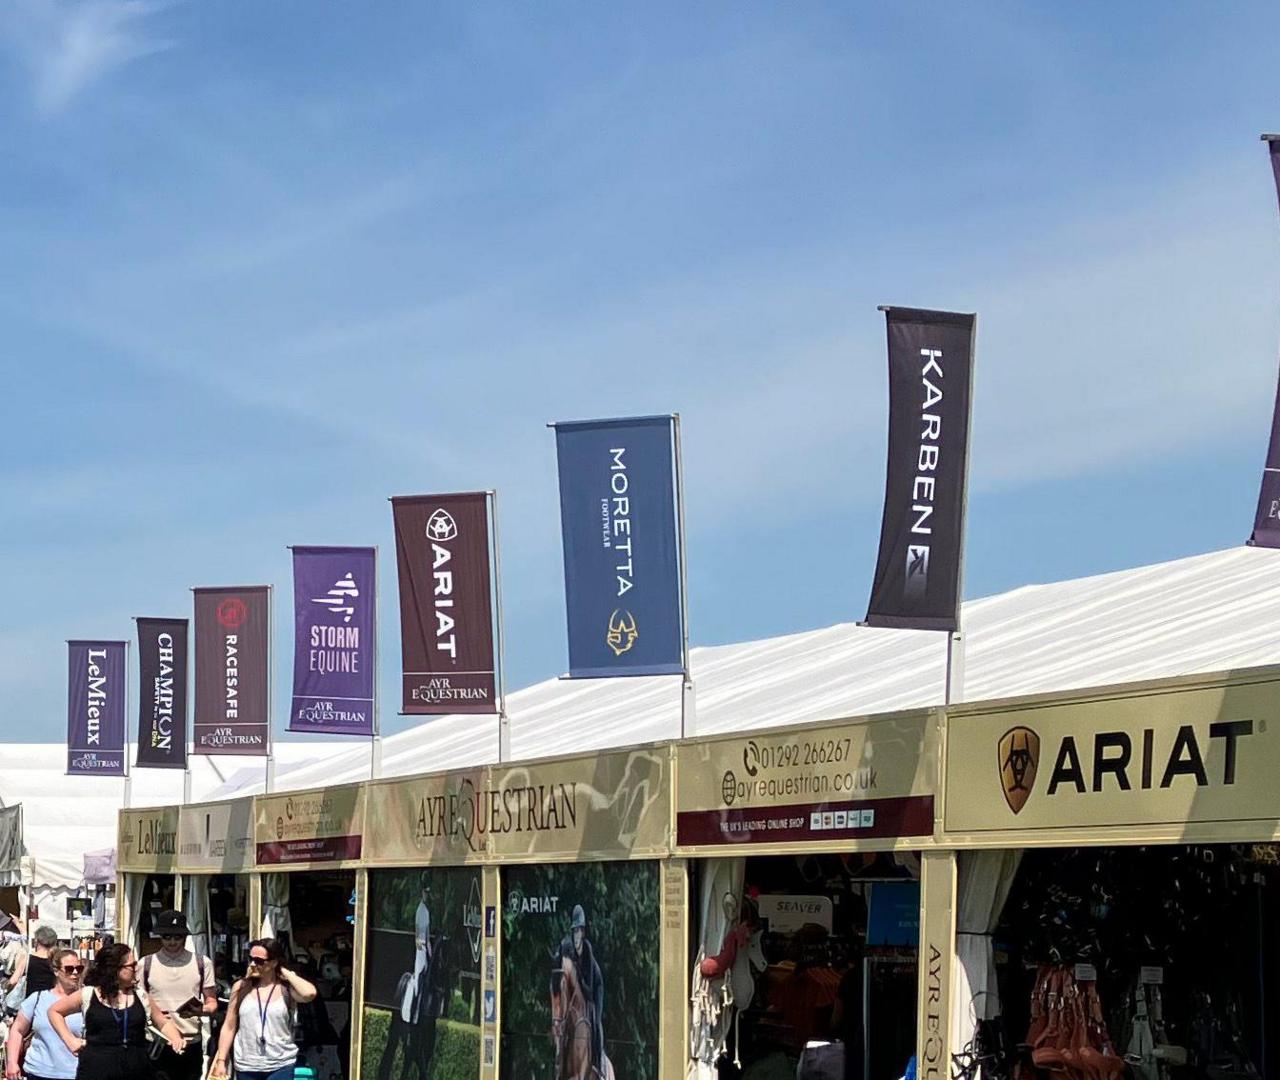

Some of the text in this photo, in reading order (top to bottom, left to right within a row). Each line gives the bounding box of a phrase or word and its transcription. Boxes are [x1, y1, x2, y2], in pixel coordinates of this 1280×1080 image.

[911, 348, 943, 534] KARBEN
[609, 448, 634, 597] MORETTA
[431, 543, 457, 658] ARIAT
[311, 625, 359, 648] STORM
[309, 649, 359, 675] EQUINE
[226, 634, 238, 719] RACESAFE
[428, 678, 450, 688] AYR
[87, 648, 107, 745] LeMieux
[157, 632, 173, 750] CHAMPION
[412, 686, 488, 702] EQUESTRIAN
[298, 708, 366, 723] EQUESTRIAN
[313, 701, 334, 711] AYR
[201, 733, 263, 747] EQUESTRIAN
[214, 727, 233, 737] AYR
[761, 738, 851, 769] 01292 266267
[1046, 720, 1254, 795] ARIAT
[736, 766, 878, 803] ayrequestrian.co.uk
[767, 818, 788, 830] ONLINE
[789, 817, 805, 829] SHOP
[521, 896, 559, 914] ARIAT
[776, 900, 823, 914] SEAVER
[928, 944, 942, 1006] AYR
